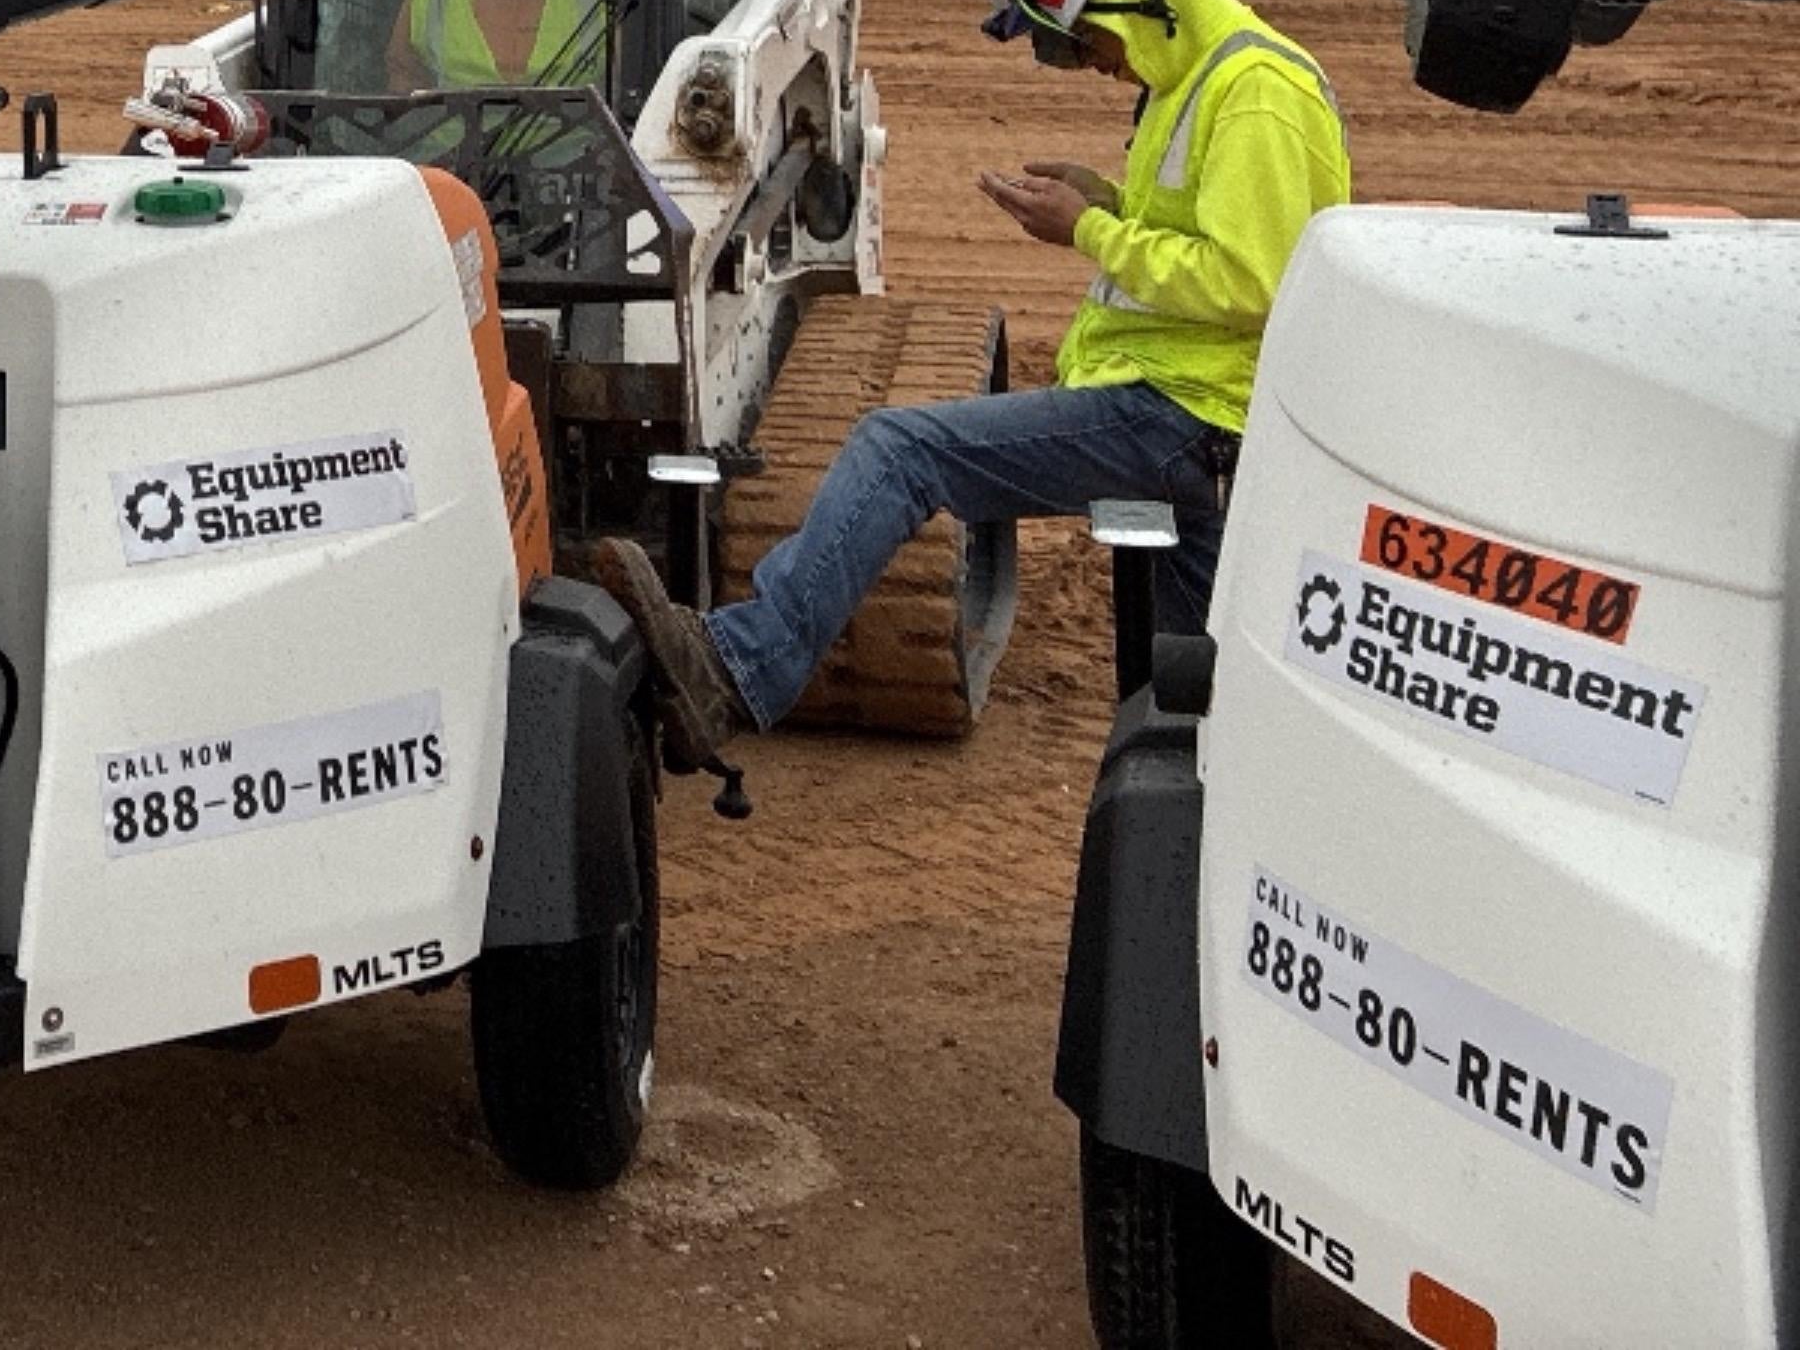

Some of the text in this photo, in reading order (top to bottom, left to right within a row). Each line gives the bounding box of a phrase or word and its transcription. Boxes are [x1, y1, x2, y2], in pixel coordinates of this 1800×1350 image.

[186, 437, 407, 502] Equipment
[195, 499, 323, 544] Share
[1378, 512, 1636, 640] 634040
[1346, 634, 1501, 735] Share
[1355, 581, 1694, 740] Equipment
[107, 740, 234, 783] CALL NOW
[112, 733, 444, 844] 888-80-RENTS
[332, 938, 446, 995] MLTS
[1255, 875, 1370, 966] CALL NOW
[1246, 920, 1650, 1190] 888-80-RENTS
[1234, 1175, 1355, 1282] MLTS
